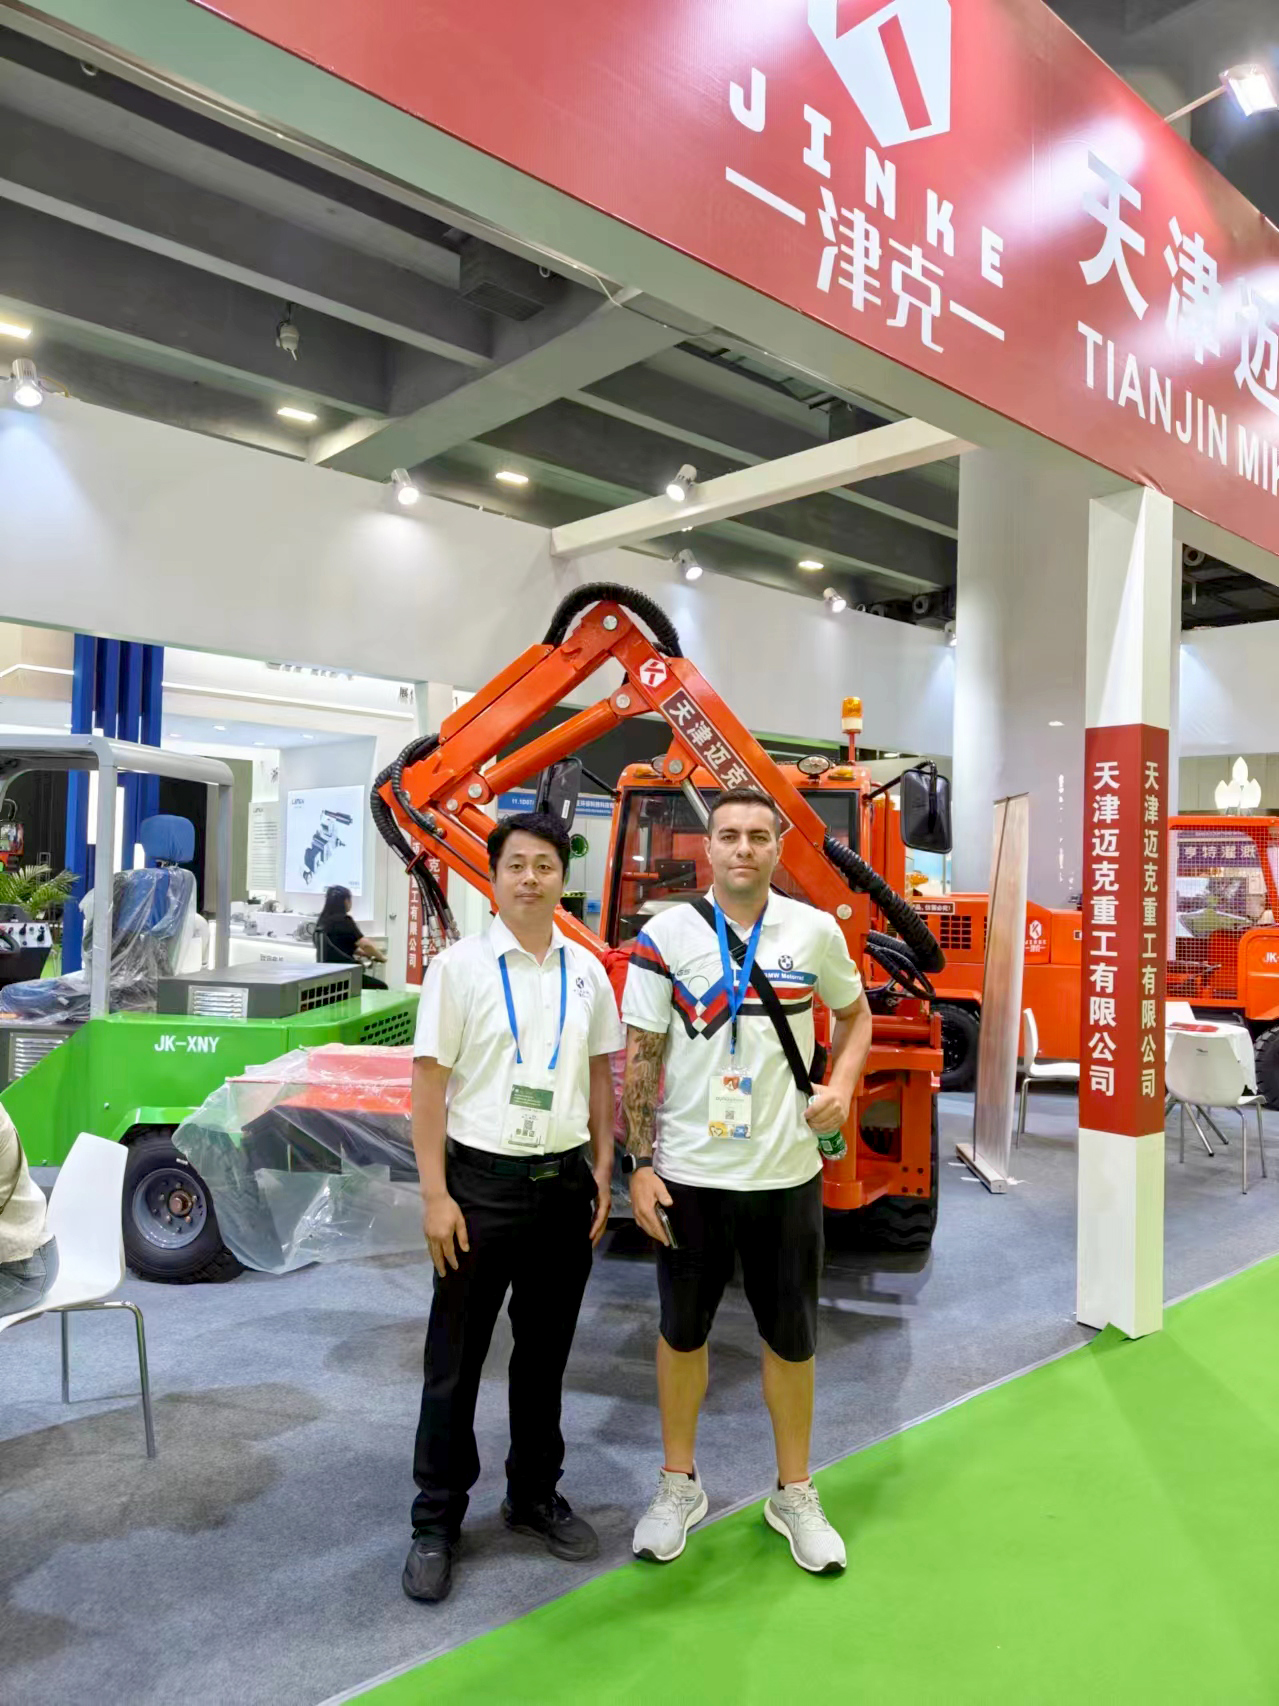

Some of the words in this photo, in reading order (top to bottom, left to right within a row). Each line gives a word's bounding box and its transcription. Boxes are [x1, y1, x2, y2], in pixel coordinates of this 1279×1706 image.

[729, 66, 1004, 288] JINKE
[1077, 320, 1228, 466] TIANJIN
[669, 699, 759, 793] 天津迈克
[1088, 760, 1121, 1097] 天津迈克重工有限公司
[1141, 760, 1160, 1099] 天津迈克重工有限公司
[154, 1034, 220, 1053] JK-XNY
